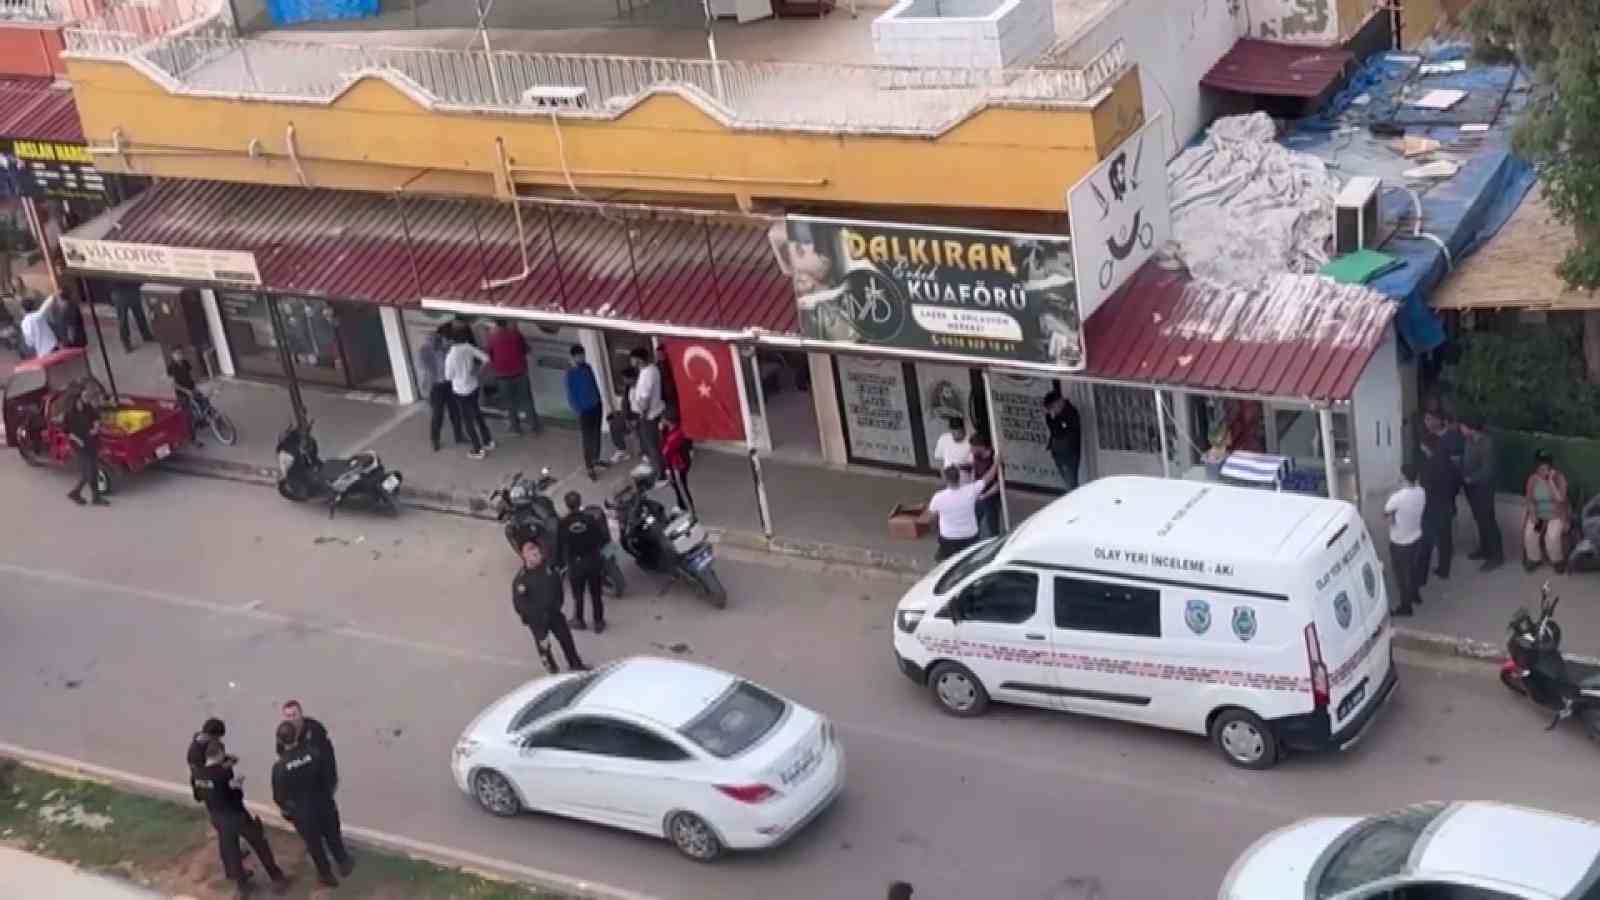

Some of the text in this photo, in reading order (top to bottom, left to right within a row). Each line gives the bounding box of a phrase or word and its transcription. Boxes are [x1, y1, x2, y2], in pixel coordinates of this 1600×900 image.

[840, 227, 1016, 274] DALKIRAN
[907, 279, 1026, 310] KUAFÖRÜ
[1094, 546, 1121, 561] OLAY
